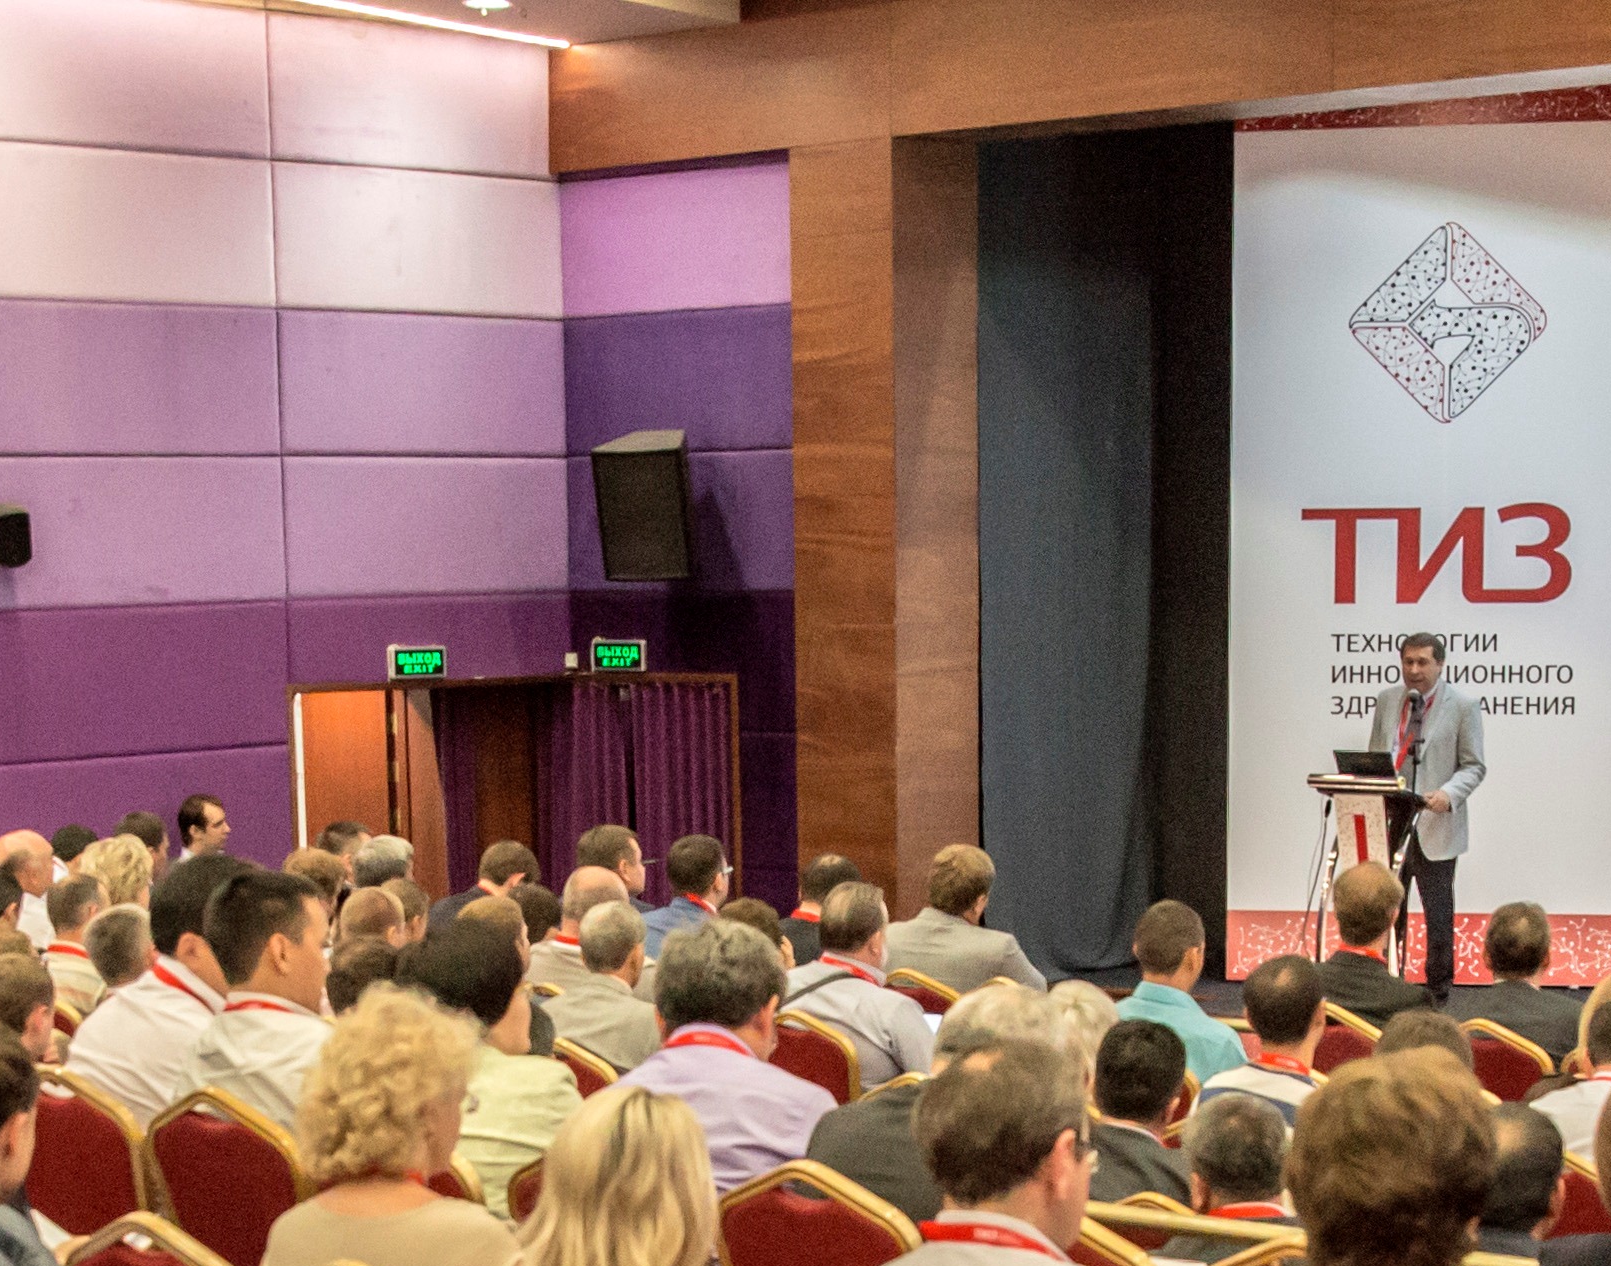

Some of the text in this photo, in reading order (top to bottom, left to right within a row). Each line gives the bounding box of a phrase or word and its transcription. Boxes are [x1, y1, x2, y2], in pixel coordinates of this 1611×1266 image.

[1301, 502, 1572, 604] ТИЗ
[1331, 633, 1498, 653] ТЕХНООГИИ
[1330, 696, 1576, 719] ЗДРАНЕНИЯ
